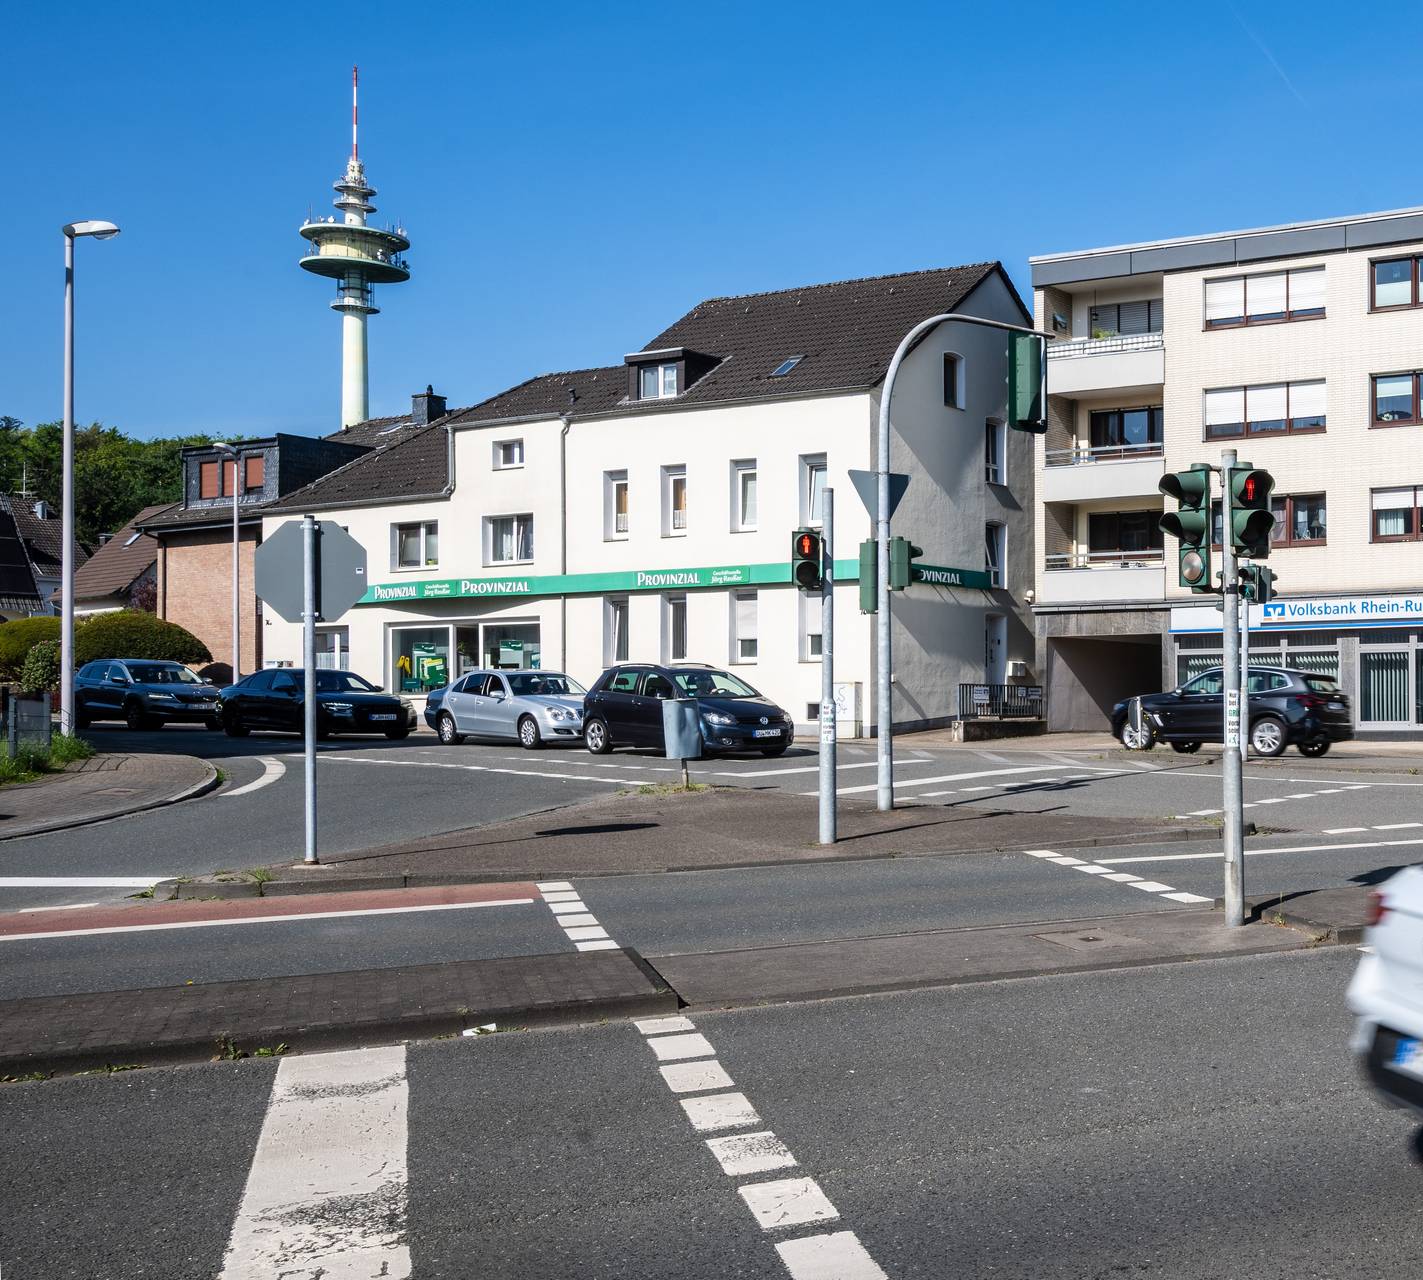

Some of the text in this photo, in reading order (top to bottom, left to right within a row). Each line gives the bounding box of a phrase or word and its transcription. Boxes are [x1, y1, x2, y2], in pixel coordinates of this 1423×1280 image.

[637, 572, 701, 586] PROVINZIAL
[374, 586, 416, 599] PROVINZIAL
[461, 580, 531, 594] PROVINZIAL
[1288, 602, 1357, 617] Volksbank
